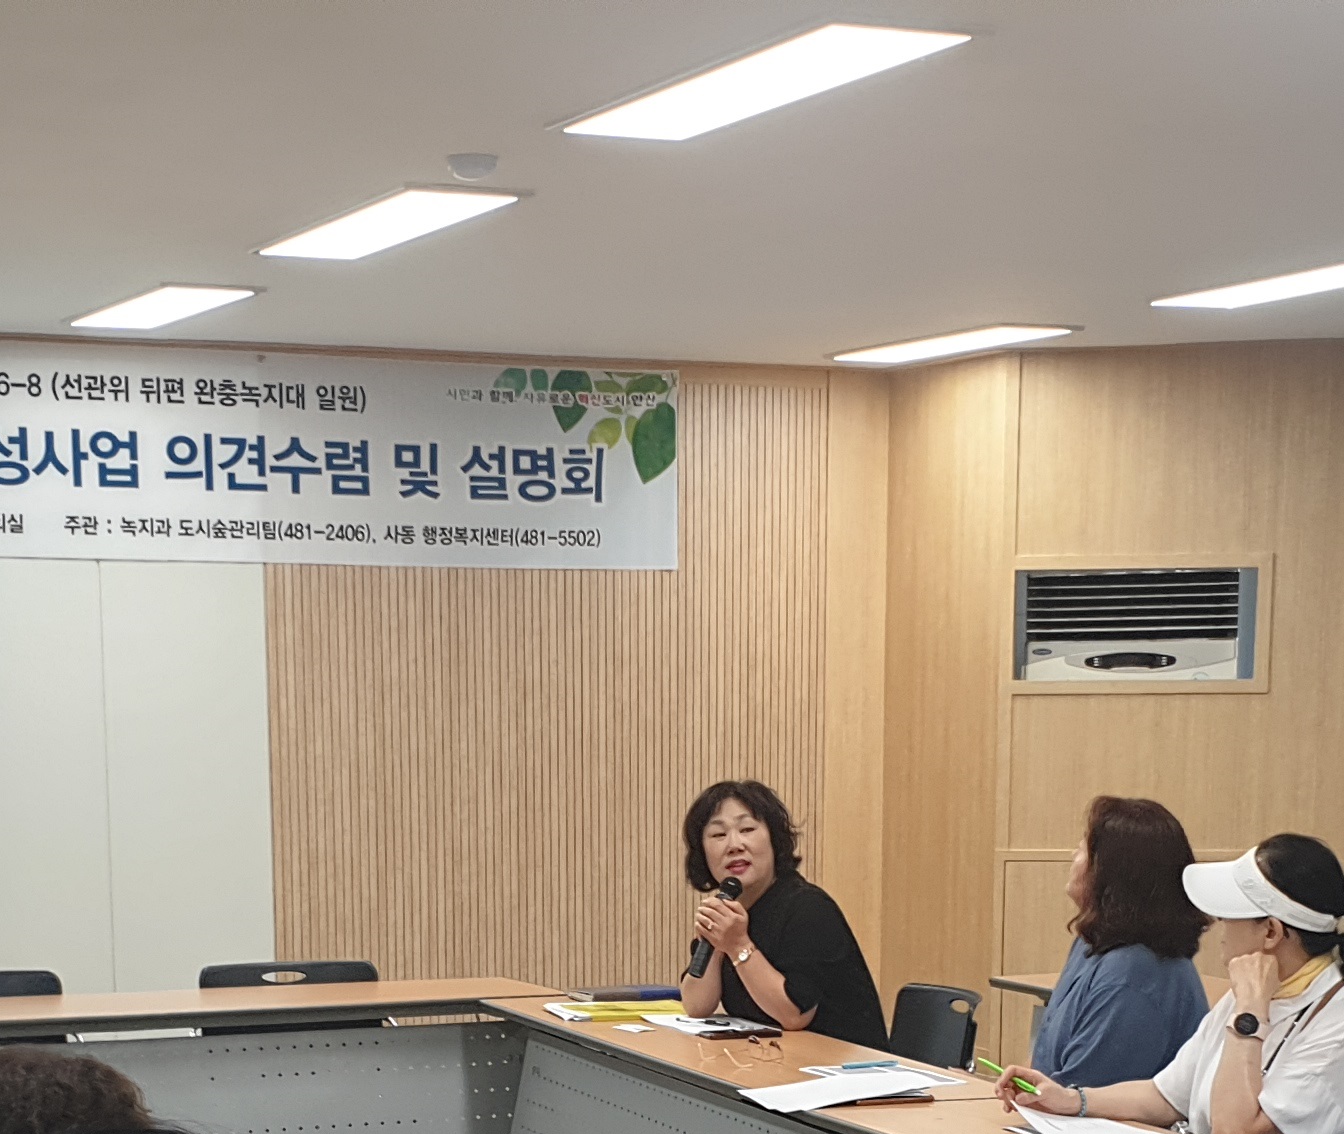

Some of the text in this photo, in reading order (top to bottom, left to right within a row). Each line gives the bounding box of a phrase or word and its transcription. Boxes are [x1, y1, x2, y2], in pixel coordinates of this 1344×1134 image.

[52, 372, 129, 402] (선관위
[140, 377, 184, 404] 뒤편
[194, 379, 305, 410] 완충녹지대
[316, 385, 366, 413] 일원)
[630, 390, 657, 408] 안산
[165, 433, 370, 496] 의견수렴
[394, 443, 440, 499] 및
[460, 446, 604, 503] 설명회
[64, 516, 98, 535] 주관
[121, 517, 171, 537] 녹지과
[179, 519, 376, 544] 도시숲관리팀(481-2406),
[384, 525, 415, 544] 사동
[423, 526, 600, 547] 행정복지센터(481-5502)
